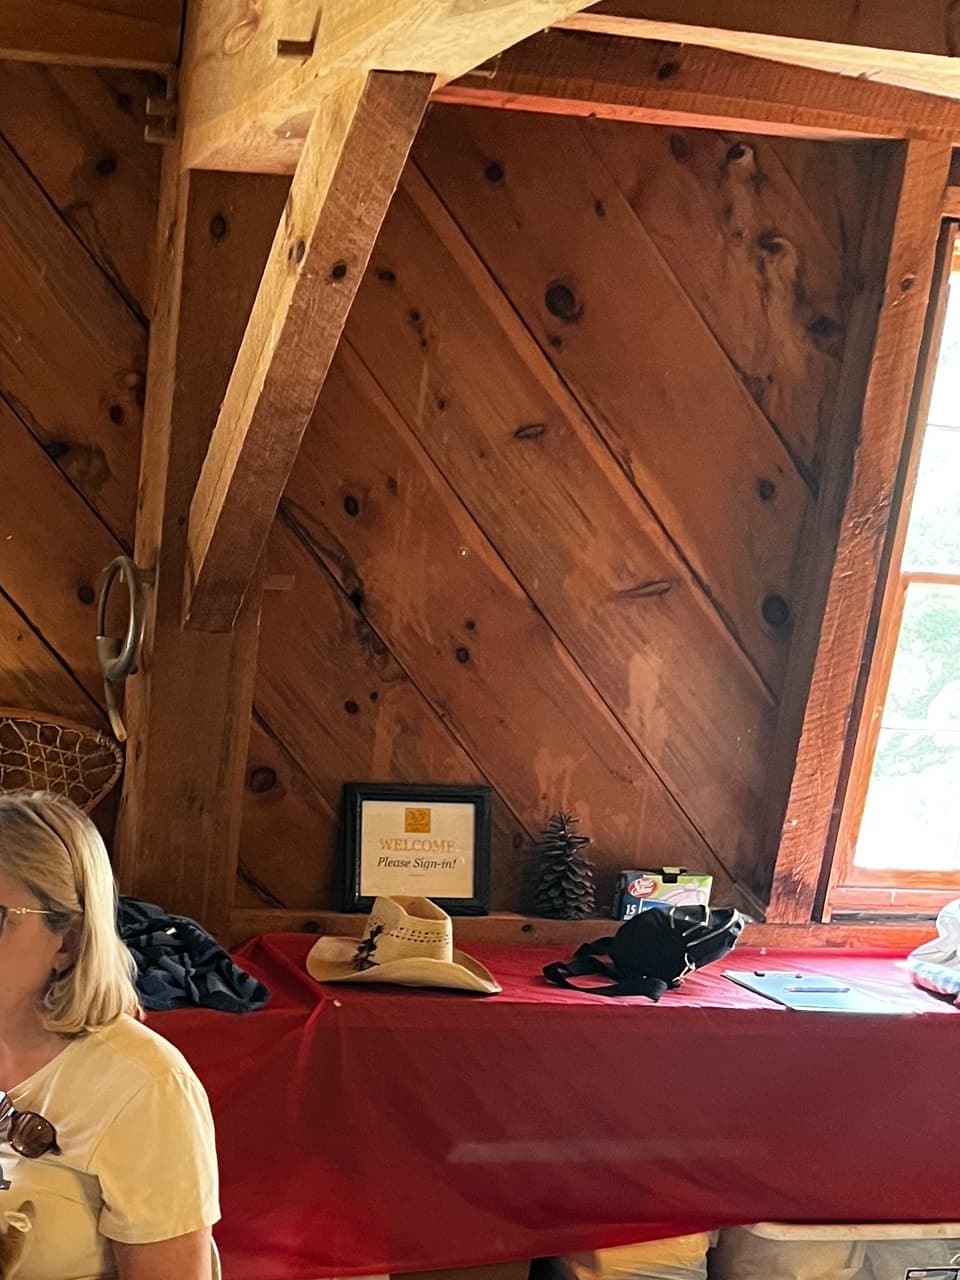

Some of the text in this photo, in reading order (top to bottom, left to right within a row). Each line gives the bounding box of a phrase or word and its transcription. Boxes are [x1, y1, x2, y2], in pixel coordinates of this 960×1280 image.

[380, 839, 456, 853] WELCOME
[378, 857, 456, 870] Please Sign-in!
